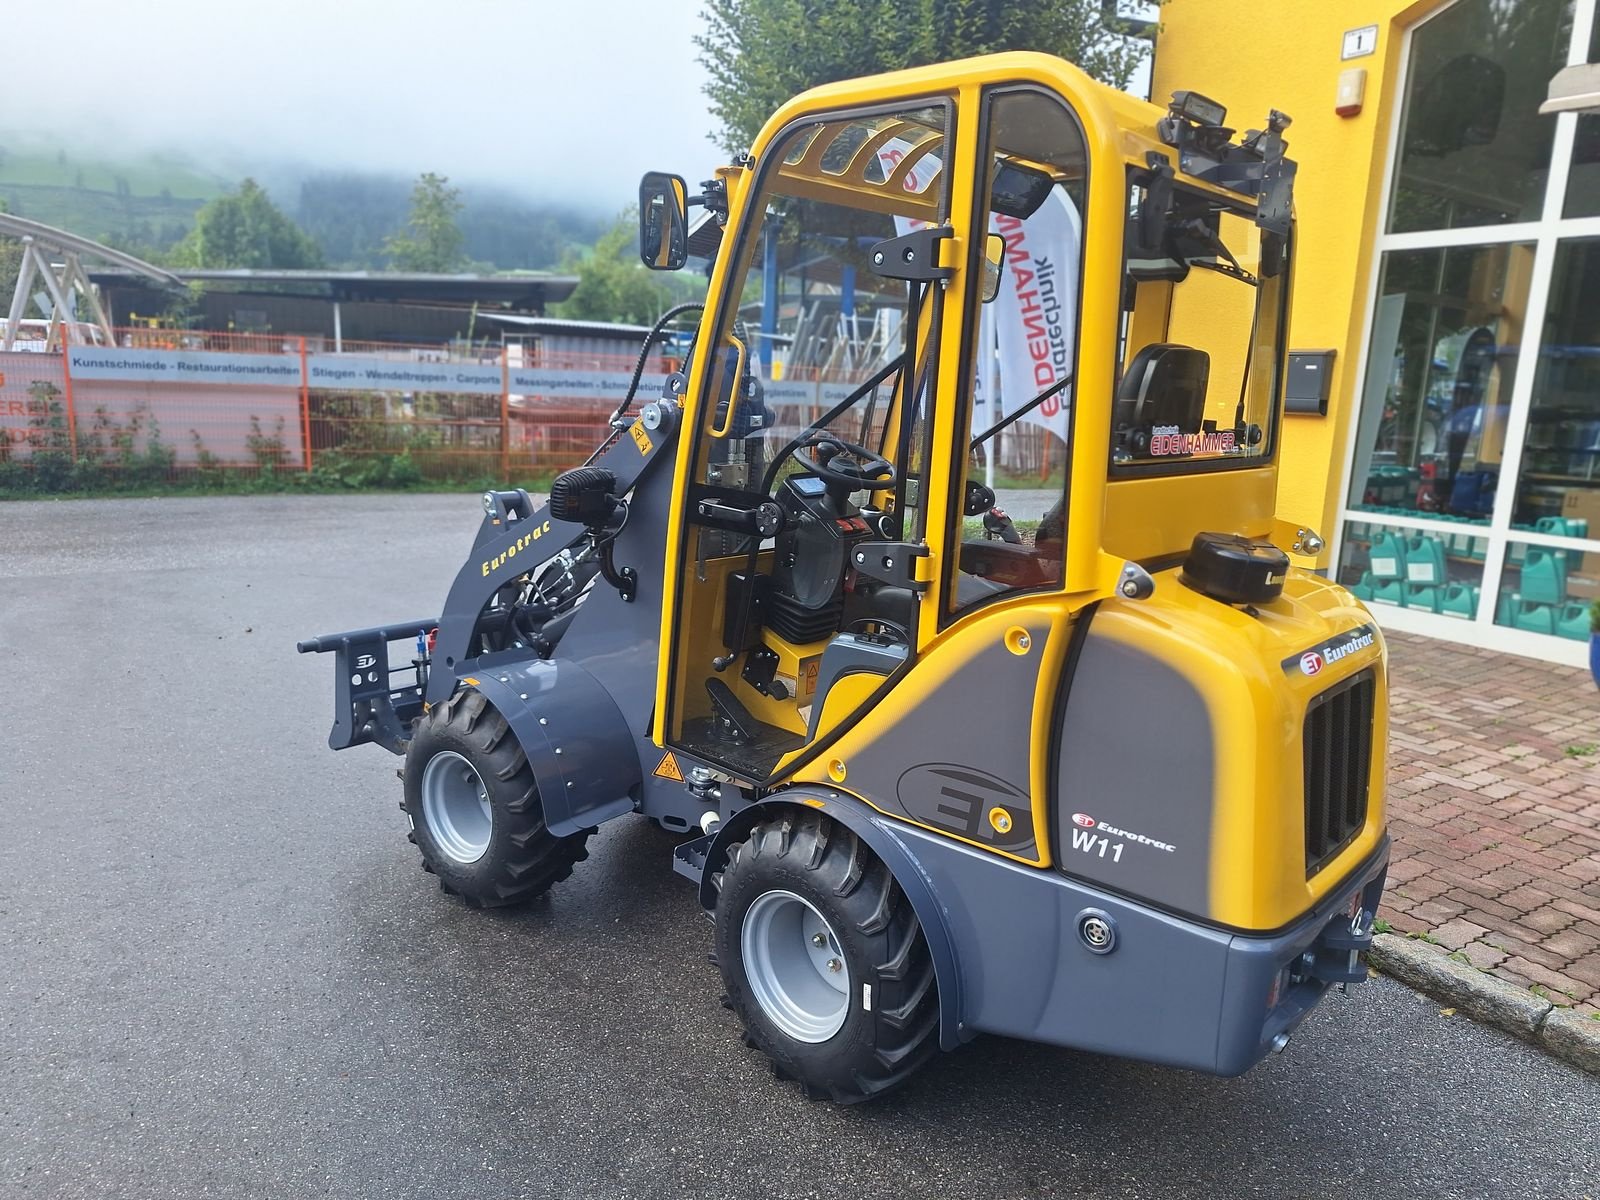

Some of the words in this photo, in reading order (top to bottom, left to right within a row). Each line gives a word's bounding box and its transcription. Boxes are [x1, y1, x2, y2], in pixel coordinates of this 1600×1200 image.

[1357, 35, 1362, 50] 1
[73, 357, 167, 370] Kunstschmiede
[177, 361, 300, 375] Restaurationsarbeiten
[312, 367, 356, 380] Stiegen
[365, 369, 447, 383] Wendeltreppen
[456, 373, 500, 385] Carports
[515, 376, 593, 389] Messingarbeiten
[1151, 432, 1235, 455] EIDENHAMMER
[482, 520, 550, 577] Eurotrac
[1323, 633, 1374, 665] Eurotrac
[1072, 828, 1124, 863] W11
[1097, 821, 1177, 853] Eurotrac
